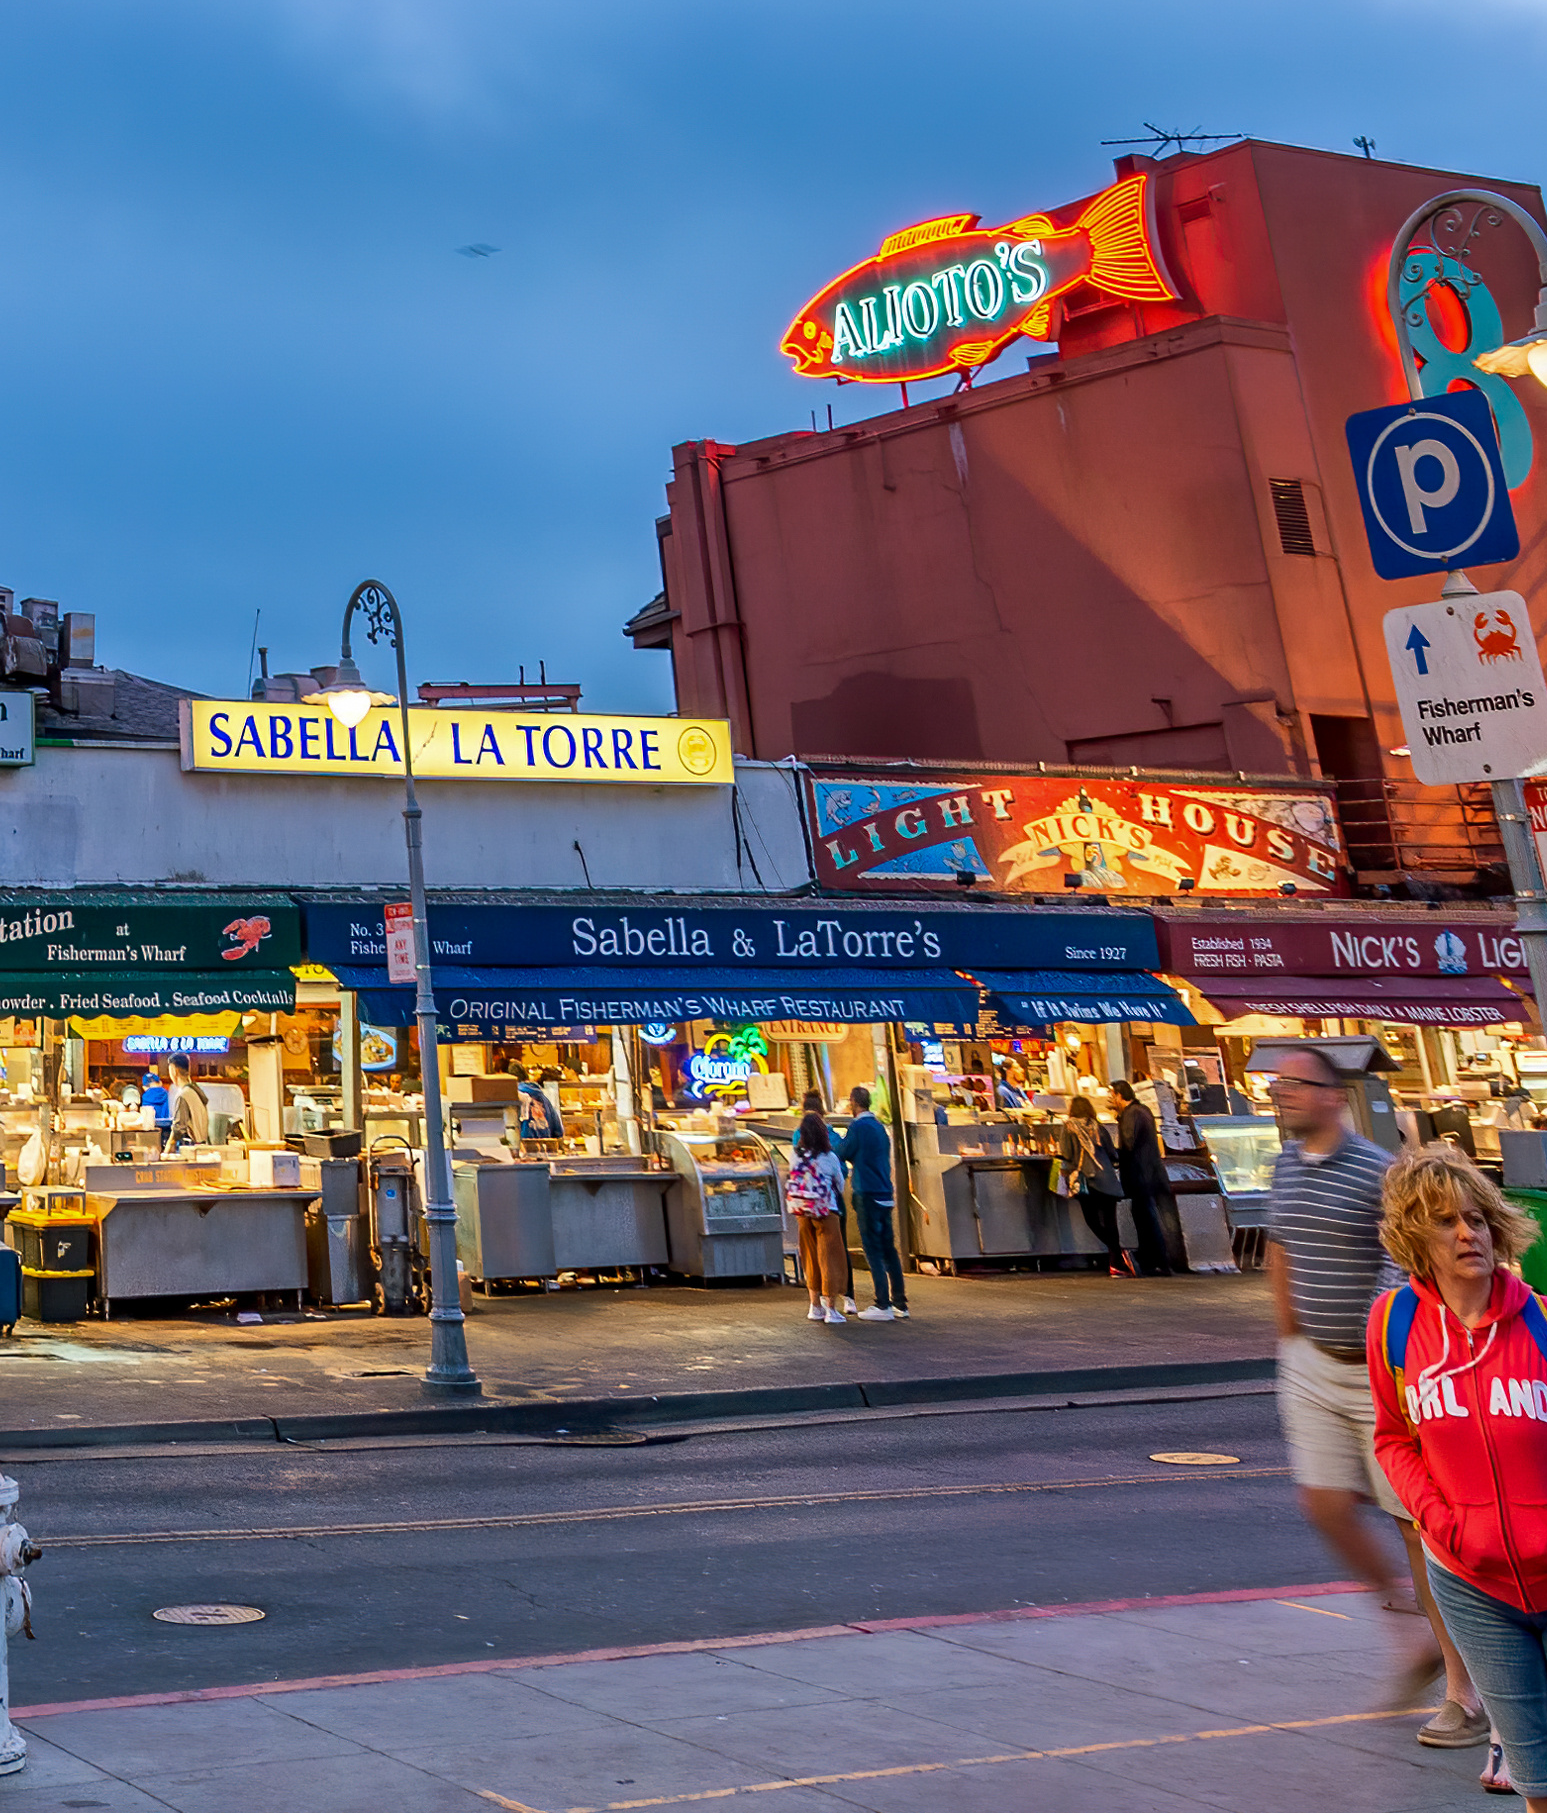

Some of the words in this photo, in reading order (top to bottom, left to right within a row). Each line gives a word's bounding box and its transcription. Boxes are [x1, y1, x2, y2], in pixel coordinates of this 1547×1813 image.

[830, 238, 1048, 364] ALIOTO'S
[1395, 439, 1461, 535] P
[1417, 688, 1535, 719] Fisherman's
[209, 712, 402, 763] SABELLA
[451, 722, 505, 765] LA
[515, 725, 662, 770] TORRE
[1422, 722, 1482, 746] Wharf
[824, 789, 1016, 871] LIGHT
[1139, 793, 1338, 882] HOUSE
[1032, 815, 1145, 850] NICK'S
[115, 923, 130, 936] at
[350, 922, 372, 937] No.
[375, 923, 384, 937] 3
[572, 917, 714, 957] Sabella
[732, 928, 756, 958] &
[773, 919, 942, 958] LaTorre's
[47, 944, 138, 962] Fisherman's
[140, 944, 187, 962] Wharf
[432, 940, 473, 955] Wharf
[1065, 946, 1097, 960] Since
[1099, 947, 1127, 960] 1927
[1191, 937, 1244, 950] Established
[1330, 931, 1421, 968] NICK'S
[1254, 954, 1284, 967] PASTA
[59, 993, 100, 1010] Fried
[102, 992, 161, 1009] Seafood
[172, 990, 231, 1008] Seafood
[450, 997, 555, 1021] ORIGINAL
[559, 996, 703, 1021] FISHERMAN'S
[701, 995, 777, 1016] WHARF
[780, 996, 905, 1018] RESTAURANT
[1404, 1006, 1447, 1021] MAINE
[1446, 1006, 1506, 1022] LOBSTER
[769, 1021, 843, 1034] ENTRANCE
